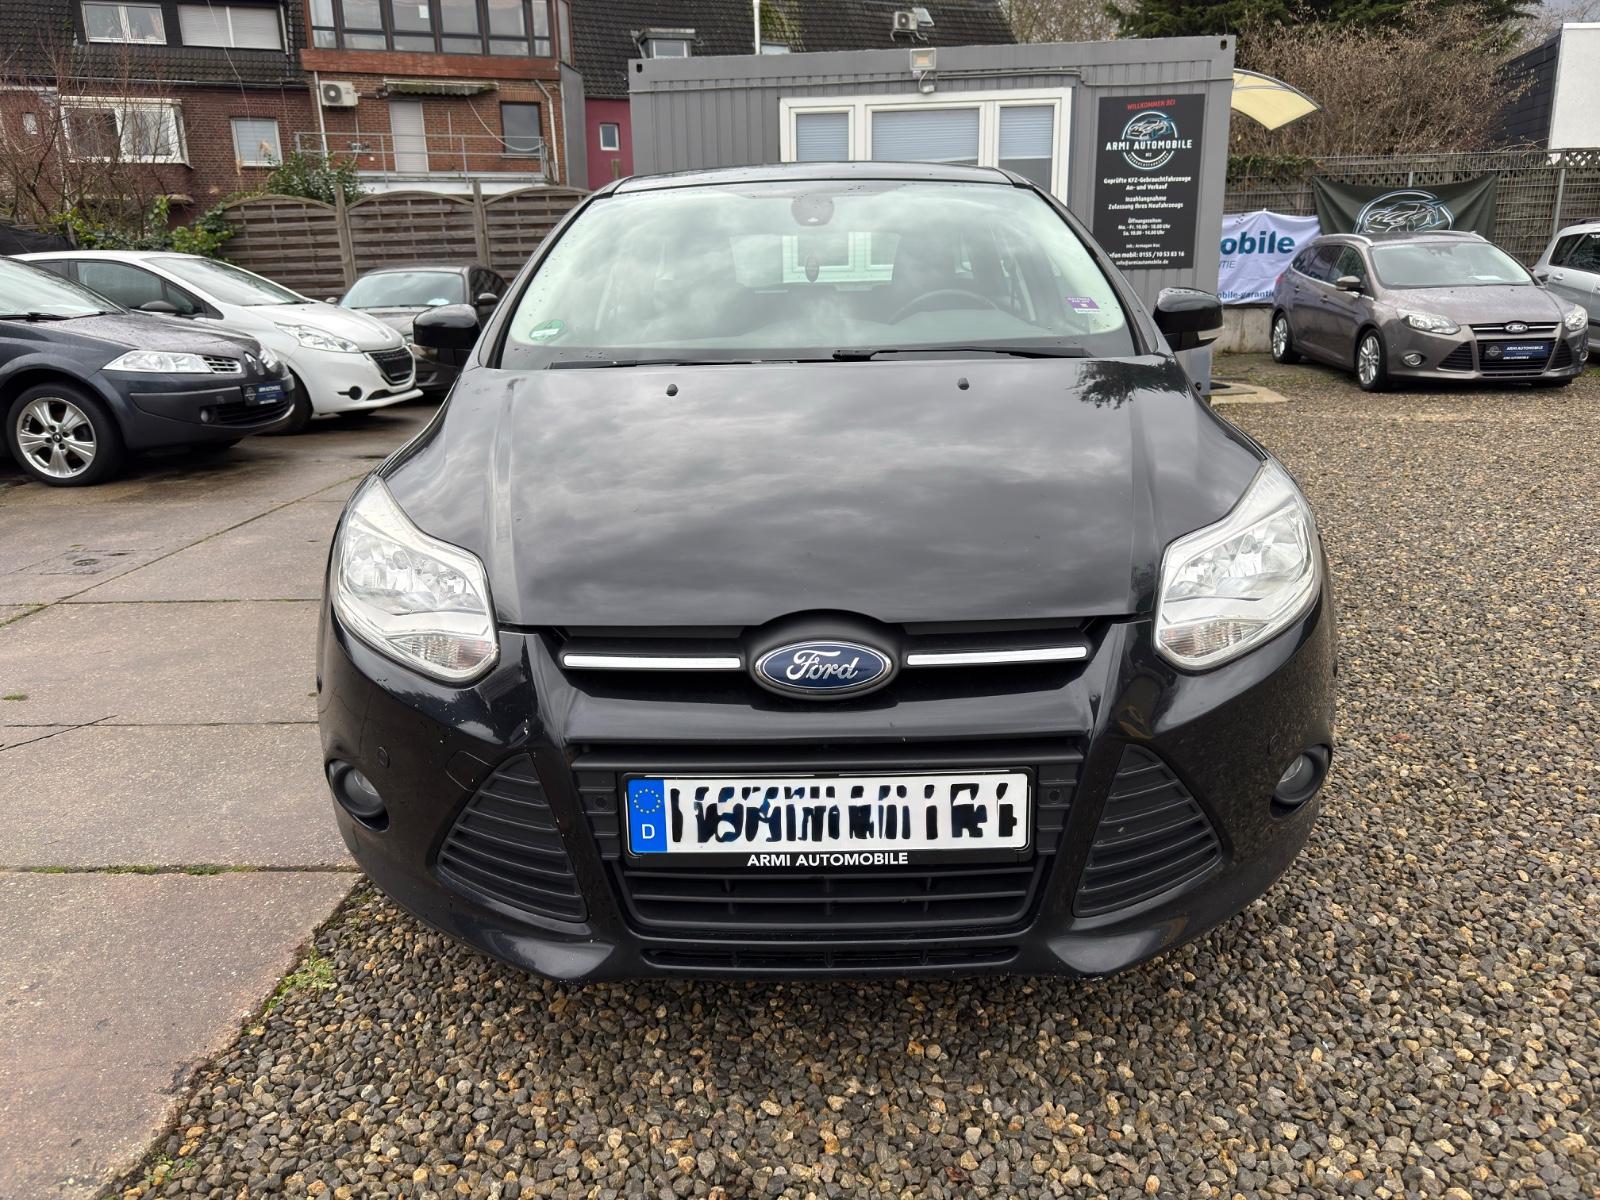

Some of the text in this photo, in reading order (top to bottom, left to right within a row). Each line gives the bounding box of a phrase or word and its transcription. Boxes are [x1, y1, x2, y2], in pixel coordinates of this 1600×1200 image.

[1127, 100, 1165, 110] WILLKOMMEN
[1105, 139, 1193, 151] ARMI AUTOMOBILE
[1103, 177, 1127, 185] Geprüfte
[1220, 230, 1295, 255] obile
[786, 650, 860, 680] Ford
[641, 824, 656, 840] D
[747, 852, 909, 867] ARMI AUTOMOBILE
